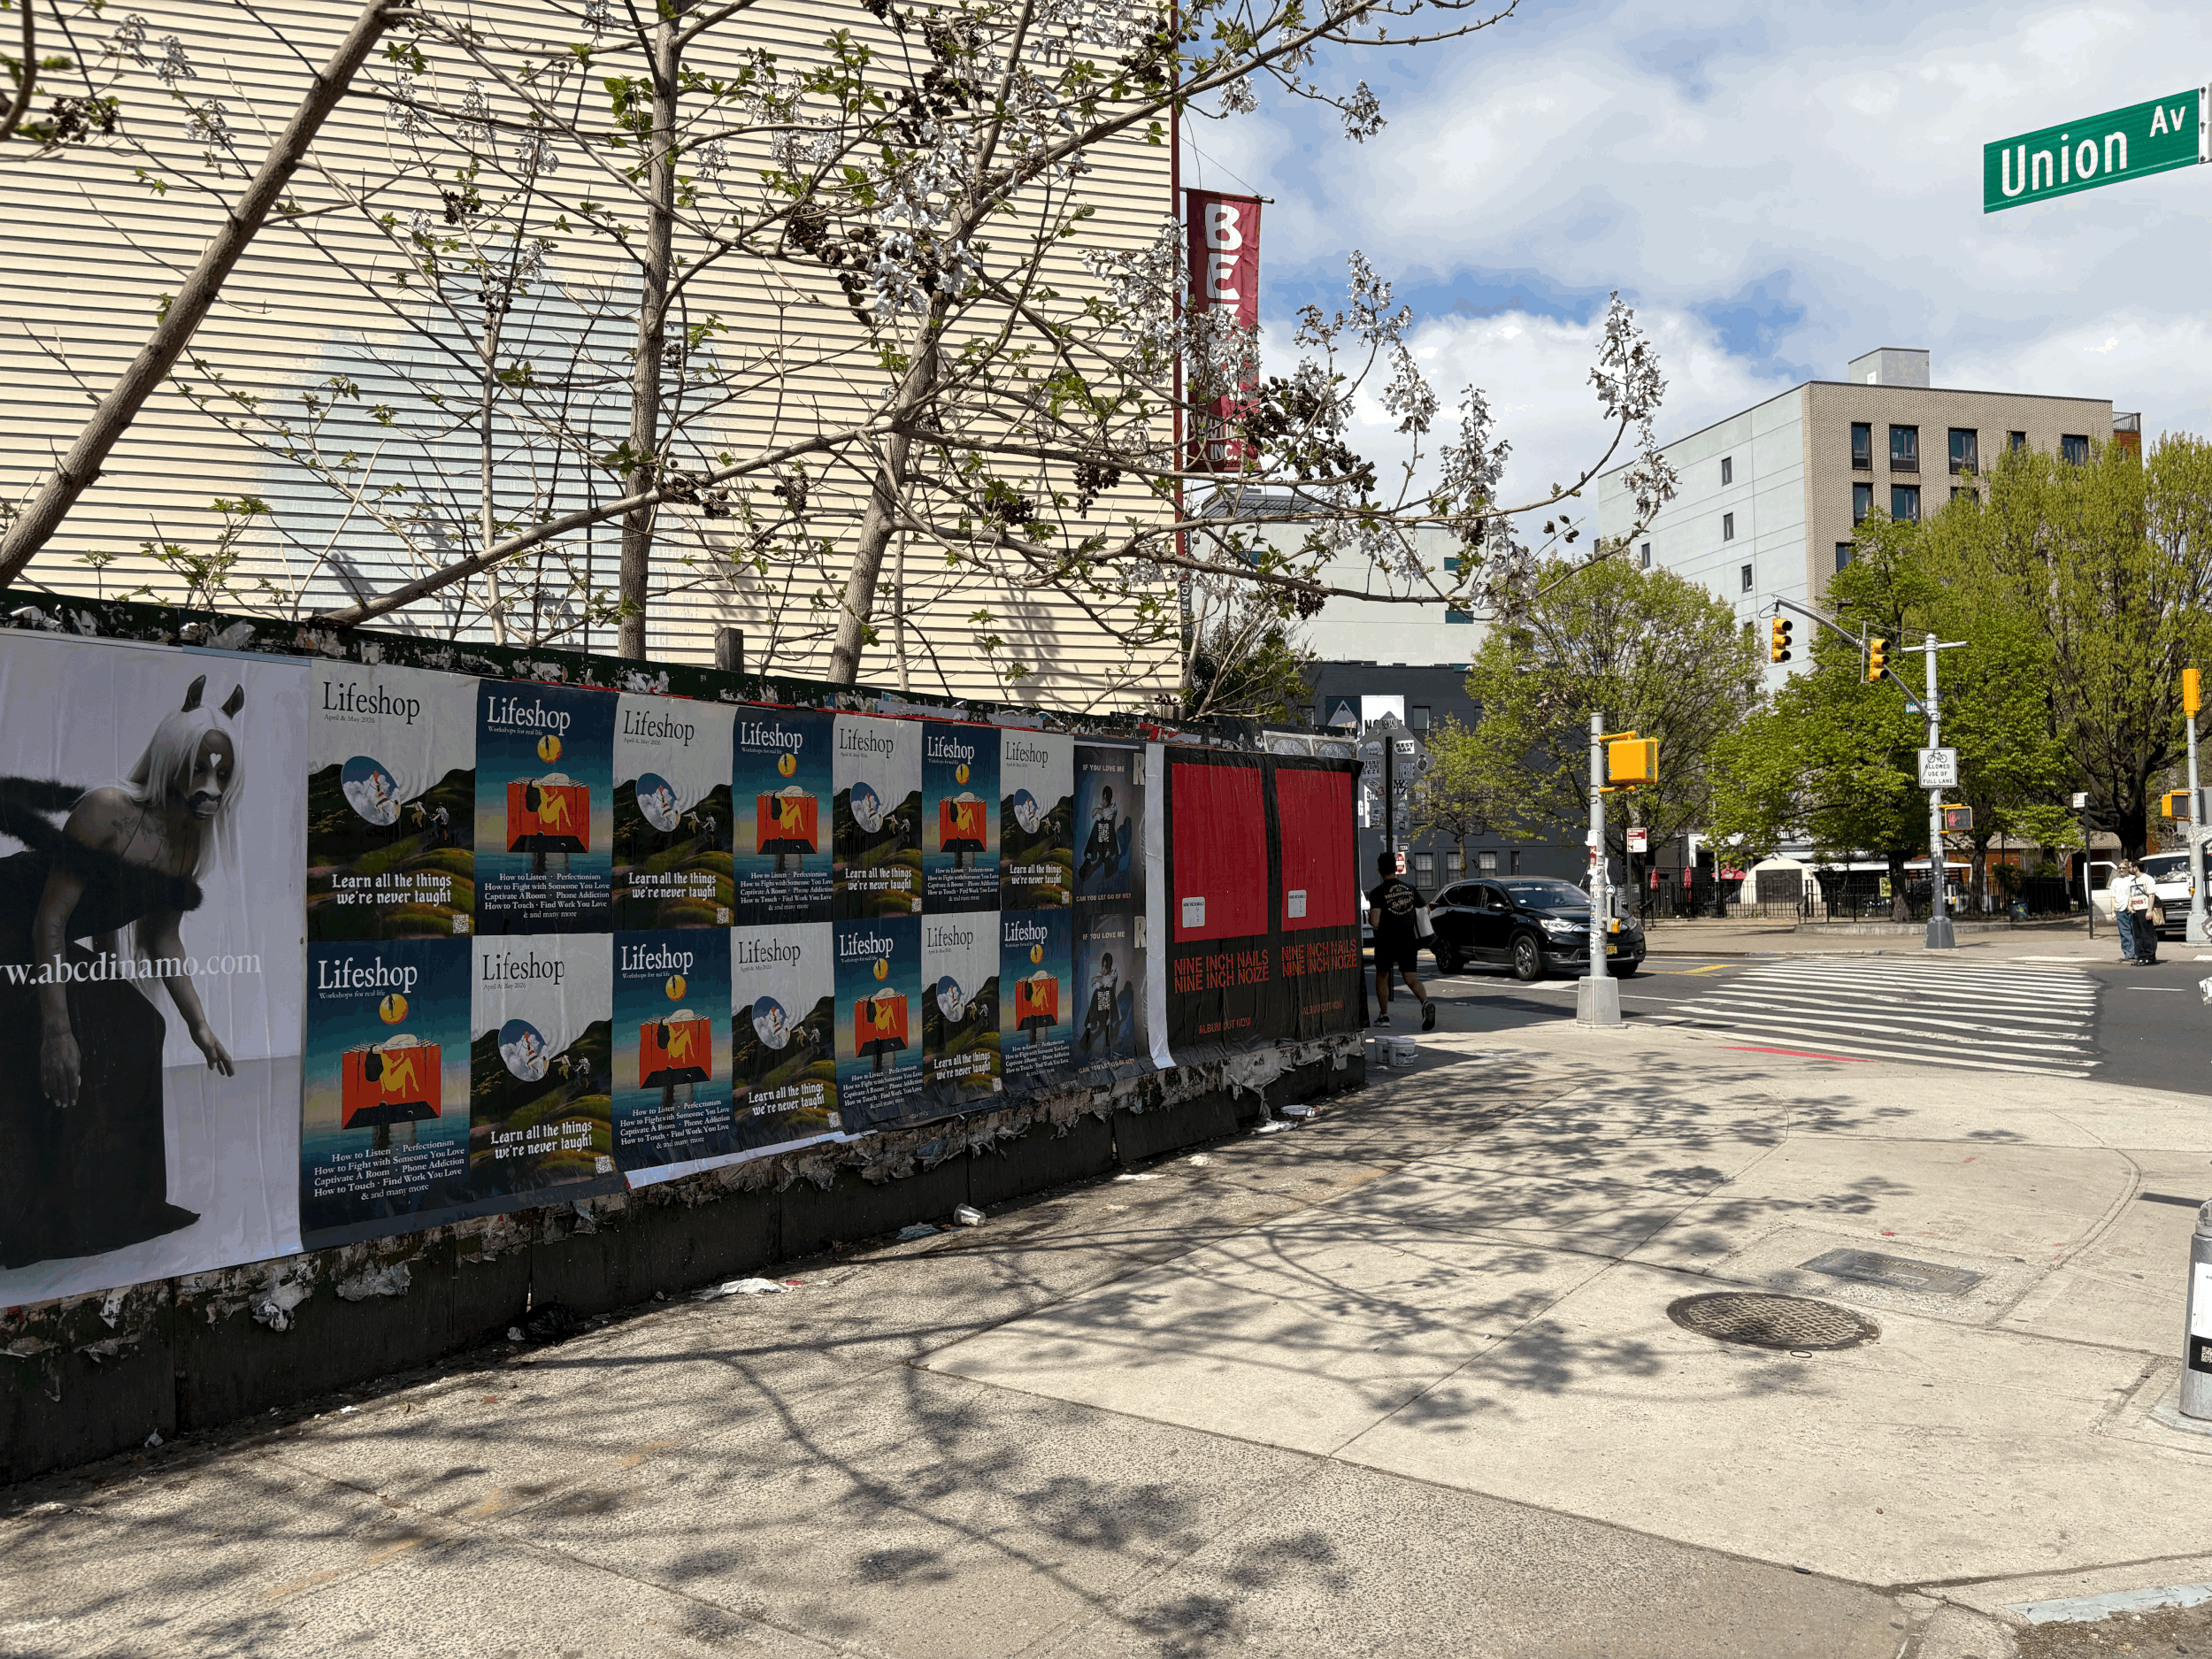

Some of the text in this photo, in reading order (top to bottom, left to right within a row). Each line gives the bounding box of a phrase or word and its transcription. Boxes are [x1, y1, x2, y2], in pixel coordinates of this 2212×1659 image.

[2001, 104, 2186, 196] Union Av
[1210, 444, 1238, 460] INC.
[322, 681, 420, 725] Lifeshop
[487, 695, 572, 736] Lifeshop
[324, 714, 339, 723] April
[623, 710, 695, 746] Lifeshop
[740, 721, 803, 755] Lifeshop
[840, 728, 894, 758] Lifeshop
[927, 735, 975, 764] Lifeshop
[1005, 741, 1048, 768] Lifeshop
[332, 873, 451, 890] Learn all the things
[628, 872, 717, 886] Learn all the things
[845, 867, 912, 879] Learn all the things
[1010, 864, 1026, 874] Learn
[1045, 864, 1062, 875] things
[1044, 874, 1062, 887] taught
[336, 888, 451, 907] we're never taught
[632, 886, 716, 902] we're never taught
[848, 879, 911, 893] we're never taught
[839, 931, 894, 958] Lifeshop
[927, 926, 973, 949] Lifeshop
[1004, 920, 1048, 945] Lifeshop
[620, 942, 694, 975] Lifeshop
[738, 938, 801, 966] Lifeshop
[1174, 949, 1269, 976] NINE INCH NAILS
[1281, 938, 1356, 962] NINE INCH NAILS
[0, 952, 262, 986] w.abcdinamo.com
[317, 956, 418, 994] Lifeshop
[482, 951, 565, 985] Lifeshop
[1282, 953, 1356, 978] NINE INCH NOIZE
[1174, 965, 1269, 994] NINE INCH NOIZE
[319, 991, 353, 1000] Workshops
[1302, 1003, 1321, 1015] ALBUM
[1321, 1002, 1331, 1012] OUT
[1199, 1017, 1251, 1034] ALBUM OUT NOW
[933, 1051, 991, 1070] Learn all the things
[955, 1066, 972, 1077] never
[972, 1061, 991, 1075] taught
[748, 1082, 824, 1104] Learn all the things
[752, 1093, 825, 1117] we're never taught
[490, 1120, 593, 1145] Learn all the things
[331, 1153, 352, 1163] How
[365, 1148, 391, 1158] Listen
[403, 1140, 455, 1153] Perfectionism
[495, 1133, 593, 1159] we're never taught
[314, 1166, 336, 1176] How
[348, 1160, 372, 1171] Fight
[373, 1157, 391, 1167] with
[393, 1153, 428, 1164] Someone
[430, 1150, 446, 1159] You
[446, 1148, 465, 1156] Love
[314, 1158, 465, 1188] Captivate A Room Phone Addiction
[313, 1187, 336, 1198] How
[347, 1180, 375, 1192] Touch
[382, 1177, 403, 1187] Find
[403, 1173, 426, 1183] Work
[426, 1171, 443, 1179] You
[443, 1168, 463, 1178] Love
[371, 1189, 384, 1200] and
[386, 1187, 407, 1196] many
[408, 1184, 430, 1193] more
